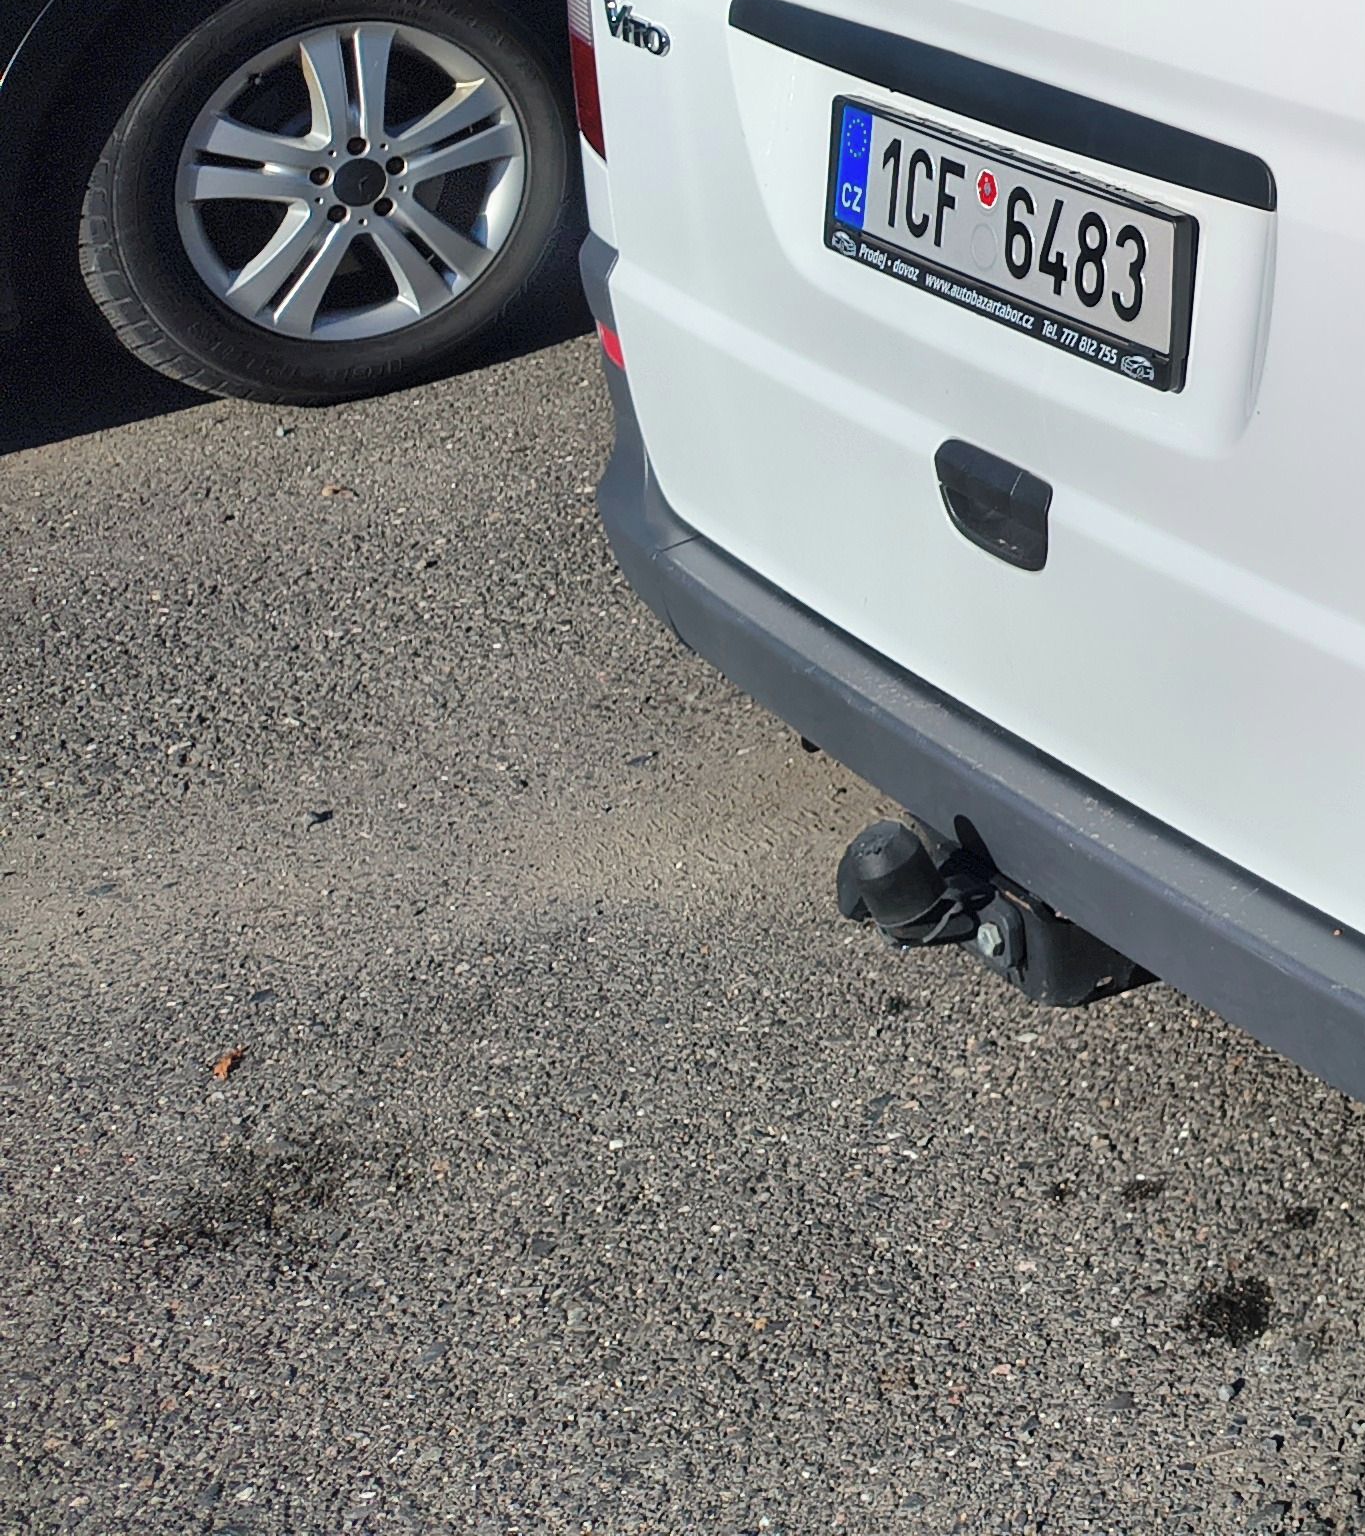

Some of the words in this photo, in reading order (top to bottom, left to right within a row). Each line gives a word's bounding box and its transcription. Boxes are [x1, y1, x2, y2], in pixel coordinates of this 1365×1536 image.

[841, 182, 863, 213] CZ
[882, 138, 966, 248] 1CF
[1004, 186, 1148, 322] 6483
[858, 243, 888, 270] Prodej
[893, 259, 920, 282] dovoz
[925, 273, 1035, 330] www.autobazartabor.cz
[1042, 319, 1058, 340] Tel.
[1060, 327, 1079, 348] 777
[1078, 336, 1098, 357] 812
[1098, 343, 1119, 365] 755
